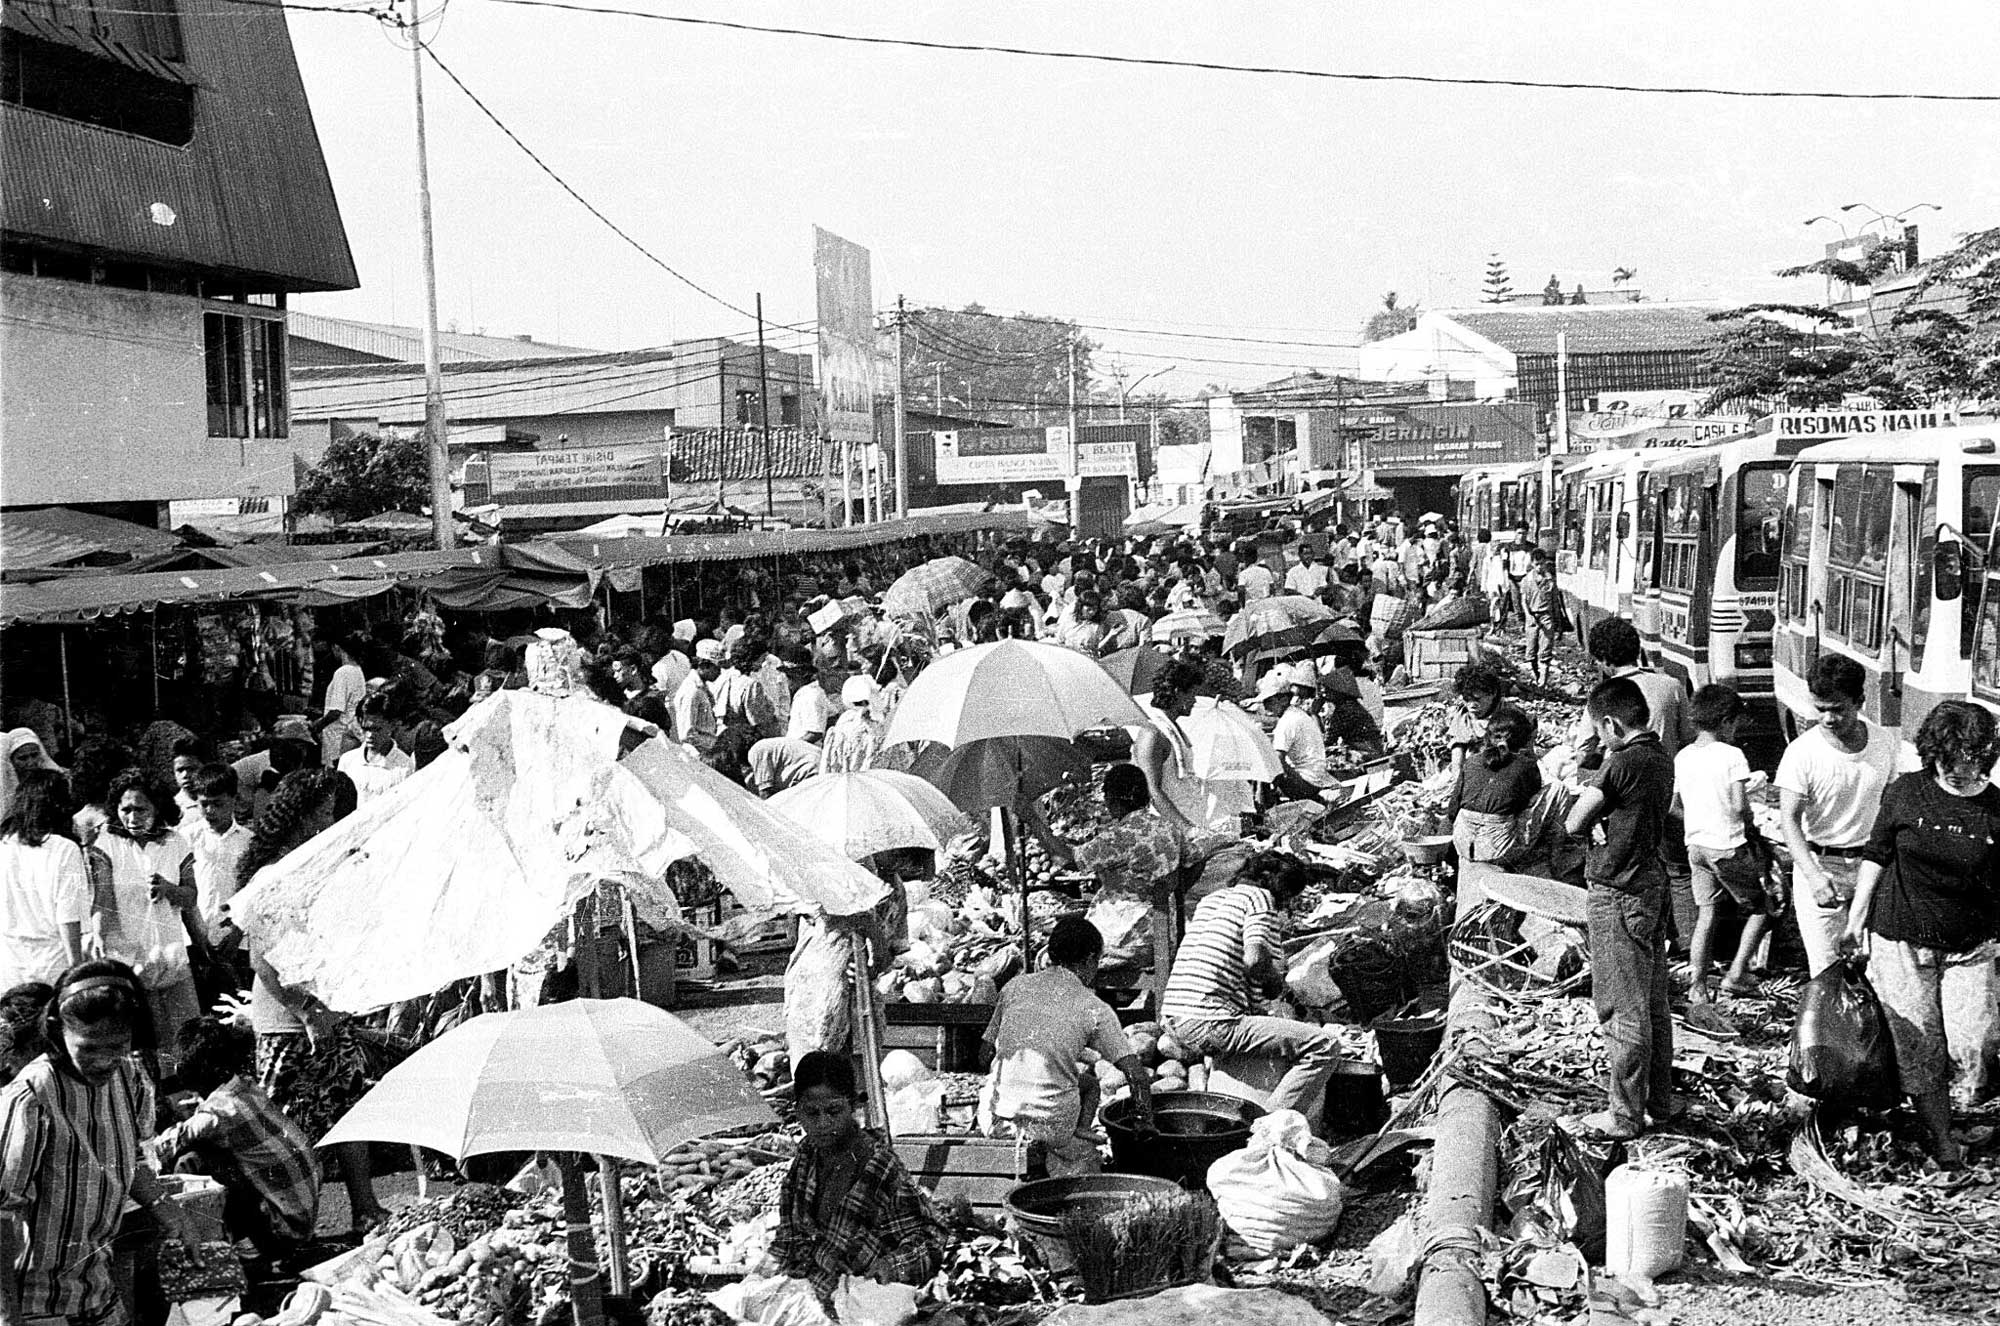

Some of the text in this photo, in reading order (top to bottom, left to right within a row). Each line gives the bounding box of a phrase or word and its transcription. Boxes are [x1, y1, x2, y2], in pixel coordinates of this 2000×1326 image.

[1780, 415, 1876, 434] RISOMAS
[1694, 425, 1726, 441] CASH
[1093, 444, 1133, 455] BEAUTY
